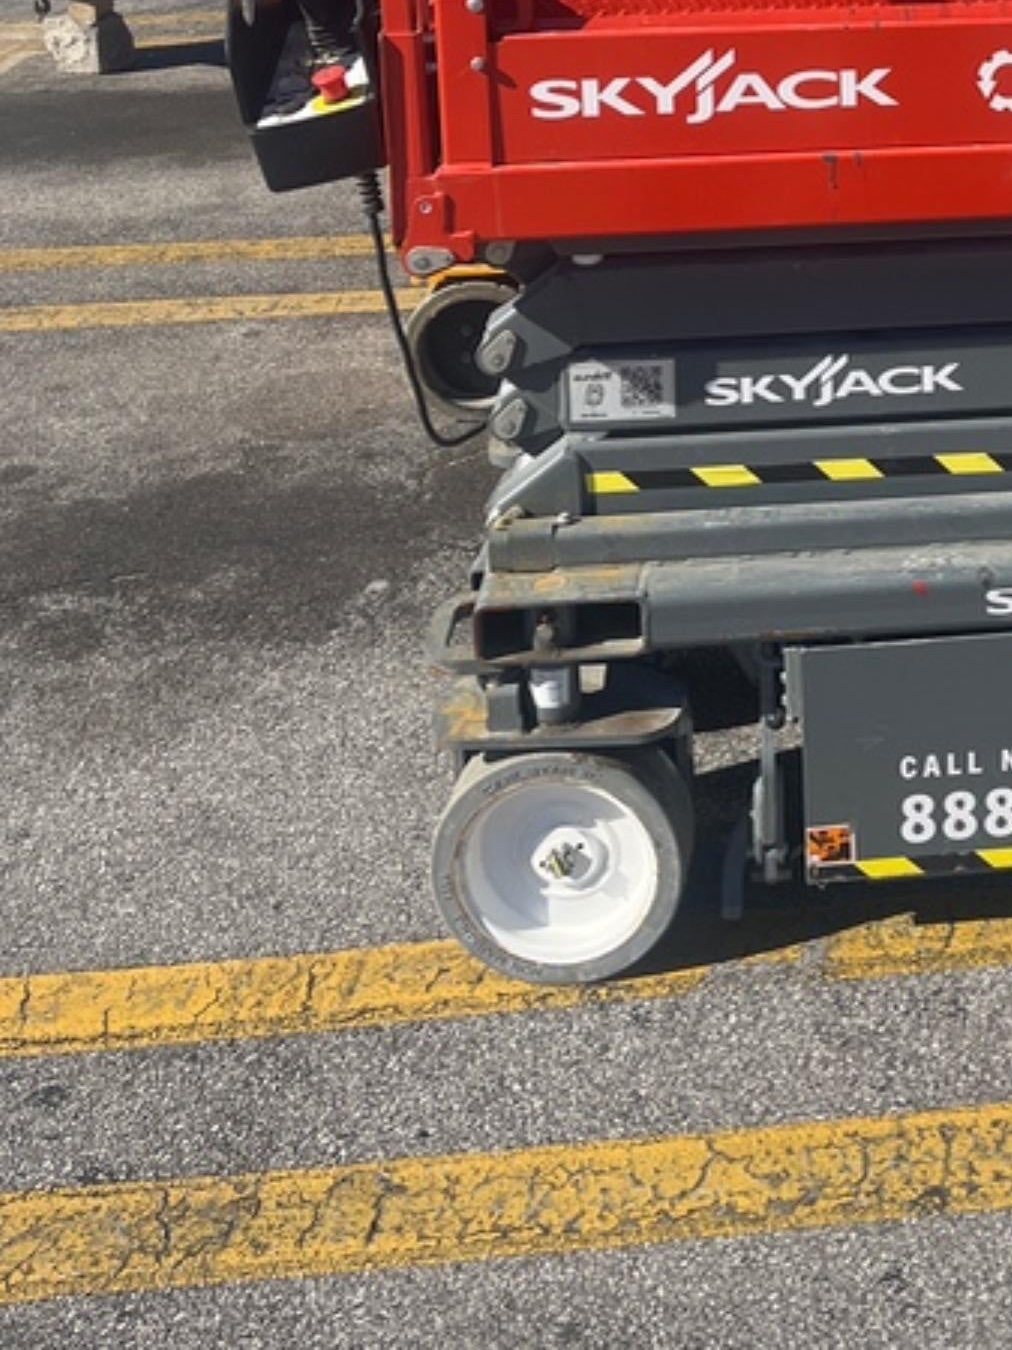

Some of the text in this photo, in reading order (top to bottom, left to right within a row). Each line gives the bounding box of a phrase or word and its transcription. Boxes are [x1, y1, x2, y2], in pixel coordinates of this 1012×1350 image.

[529, 48, 898, 124] SKYJACK
[704, 354, 964, 407] SKYJACK
[900, 753, 982, 778] CALL
